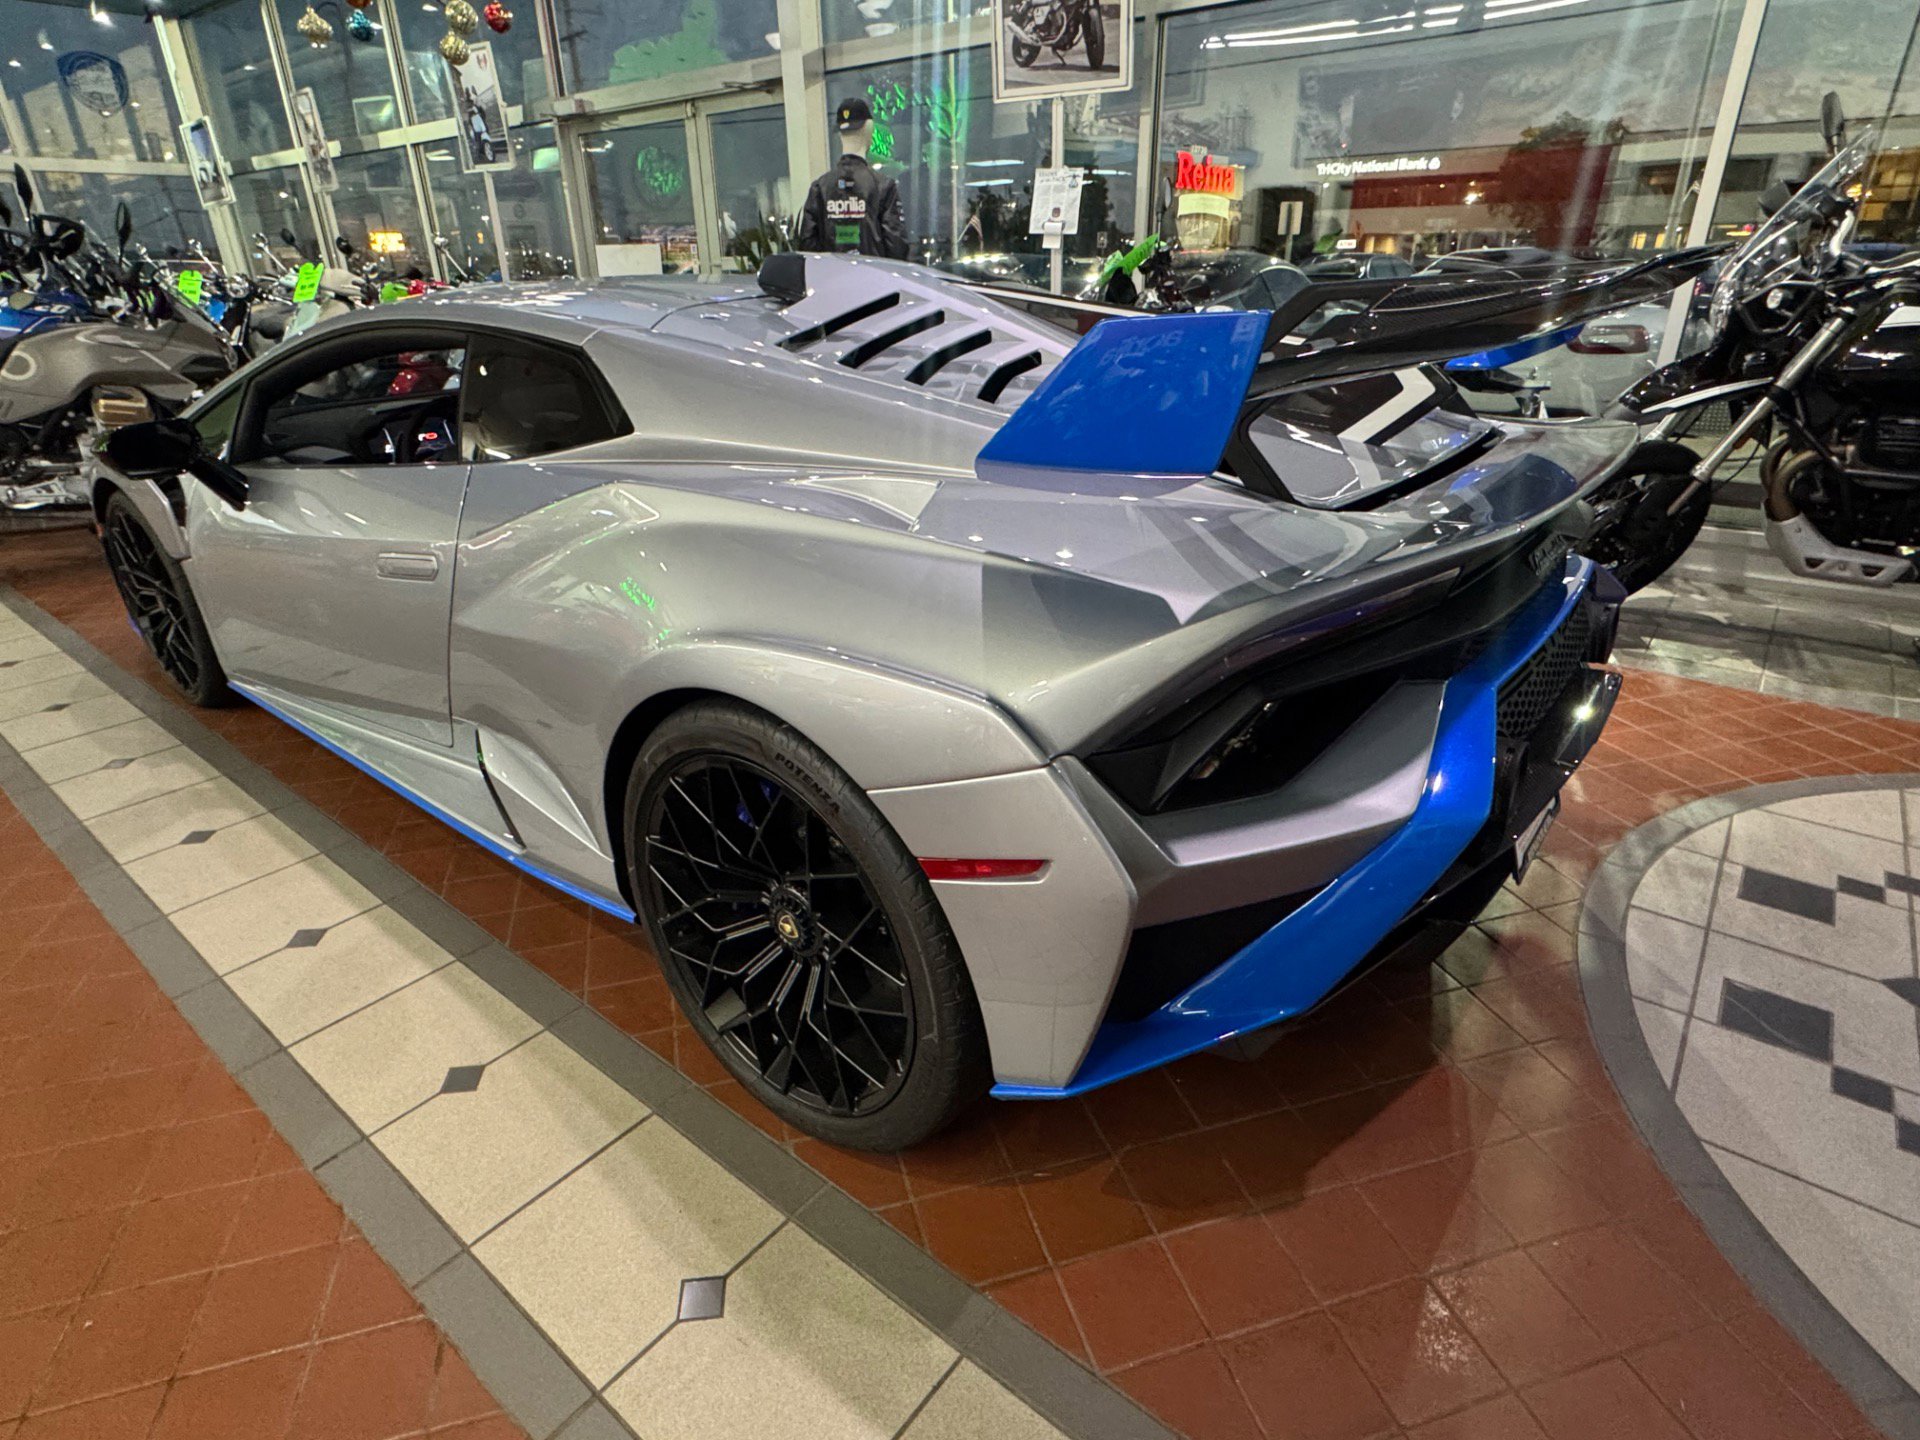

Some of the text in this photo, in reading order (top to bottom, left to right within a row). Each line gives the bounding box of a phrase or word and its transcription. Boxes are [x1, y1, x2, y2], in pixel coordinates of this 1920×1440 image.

[1175, 150, 1235, 192] Reina
[1316, 157, 1429, 176] TriCity National Bank
[826, 196, 866, 214] aprilia
[774, 752, 840, 814] POTENZA
